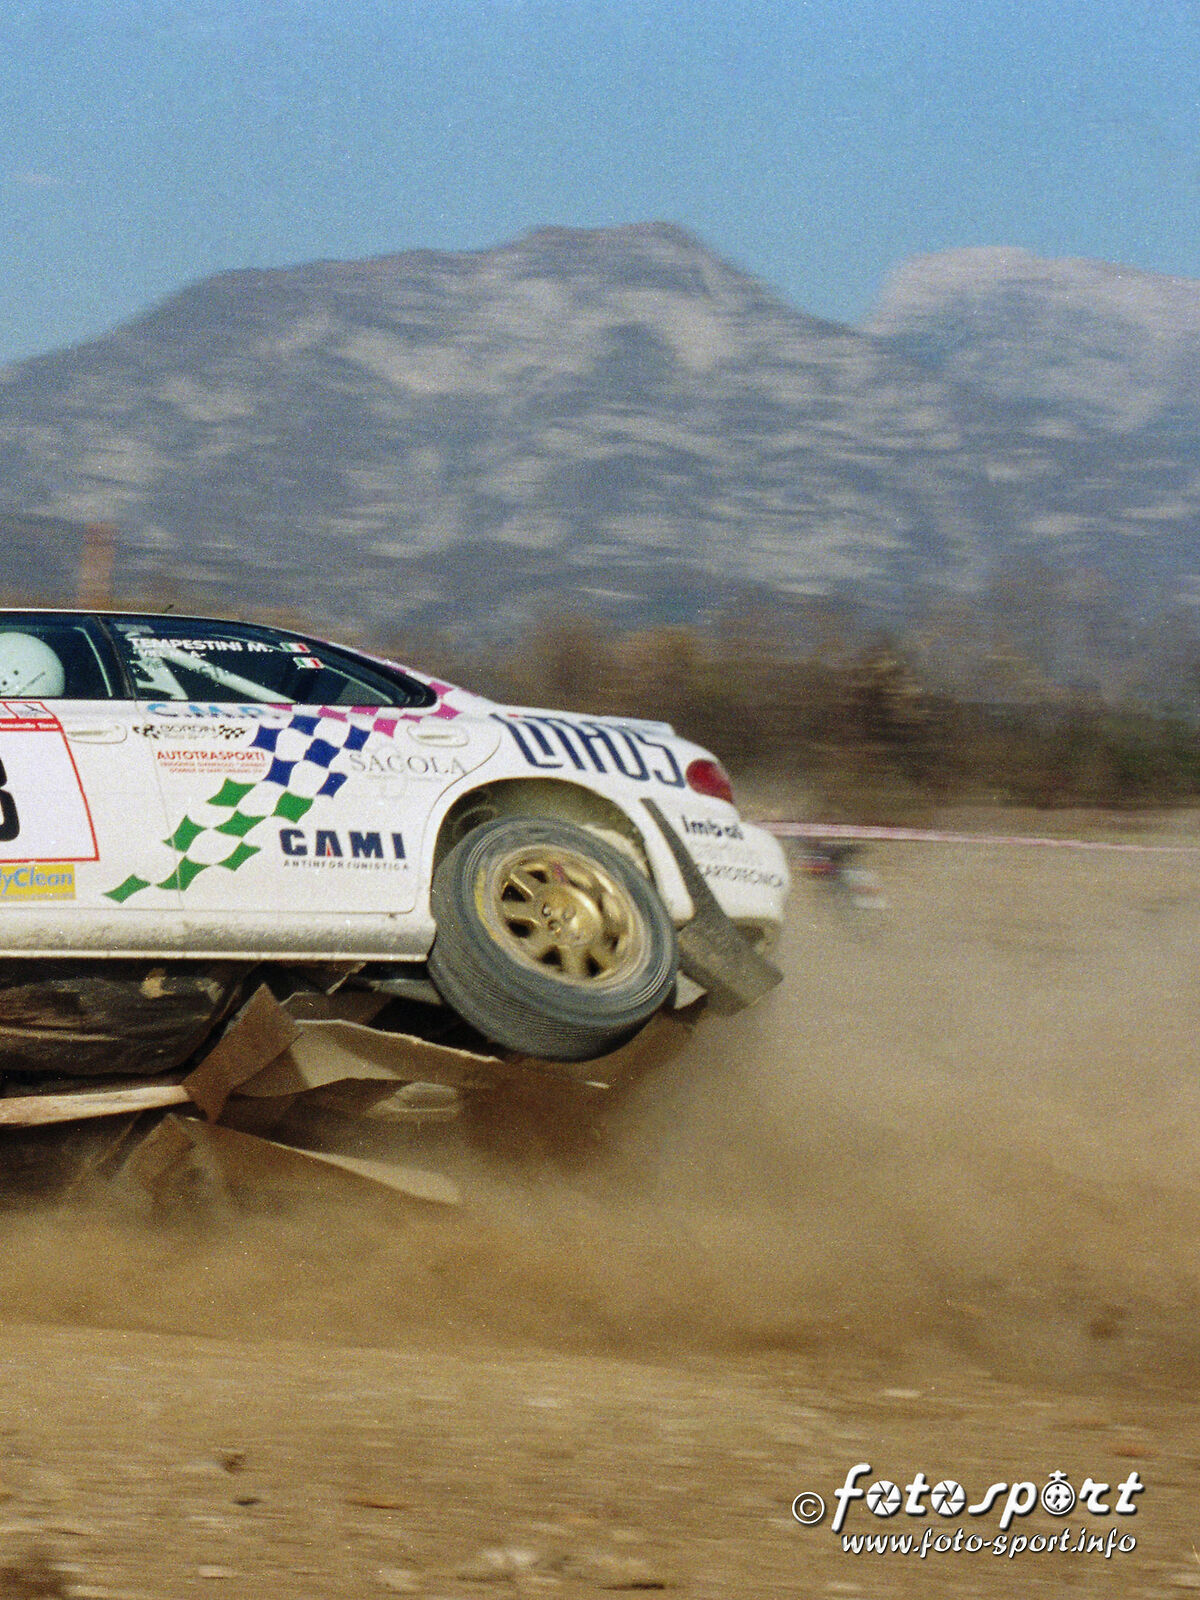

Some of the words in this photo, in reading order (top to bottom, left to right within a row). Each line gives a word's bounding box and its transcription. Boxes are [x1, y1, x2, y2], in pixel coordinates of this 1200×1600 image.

[127, 638, 243, 651] TEMPESTINI
[157, 750, 265, 761] AUTOTRASPORTI
[279, 828, 407, 860] CAMI
